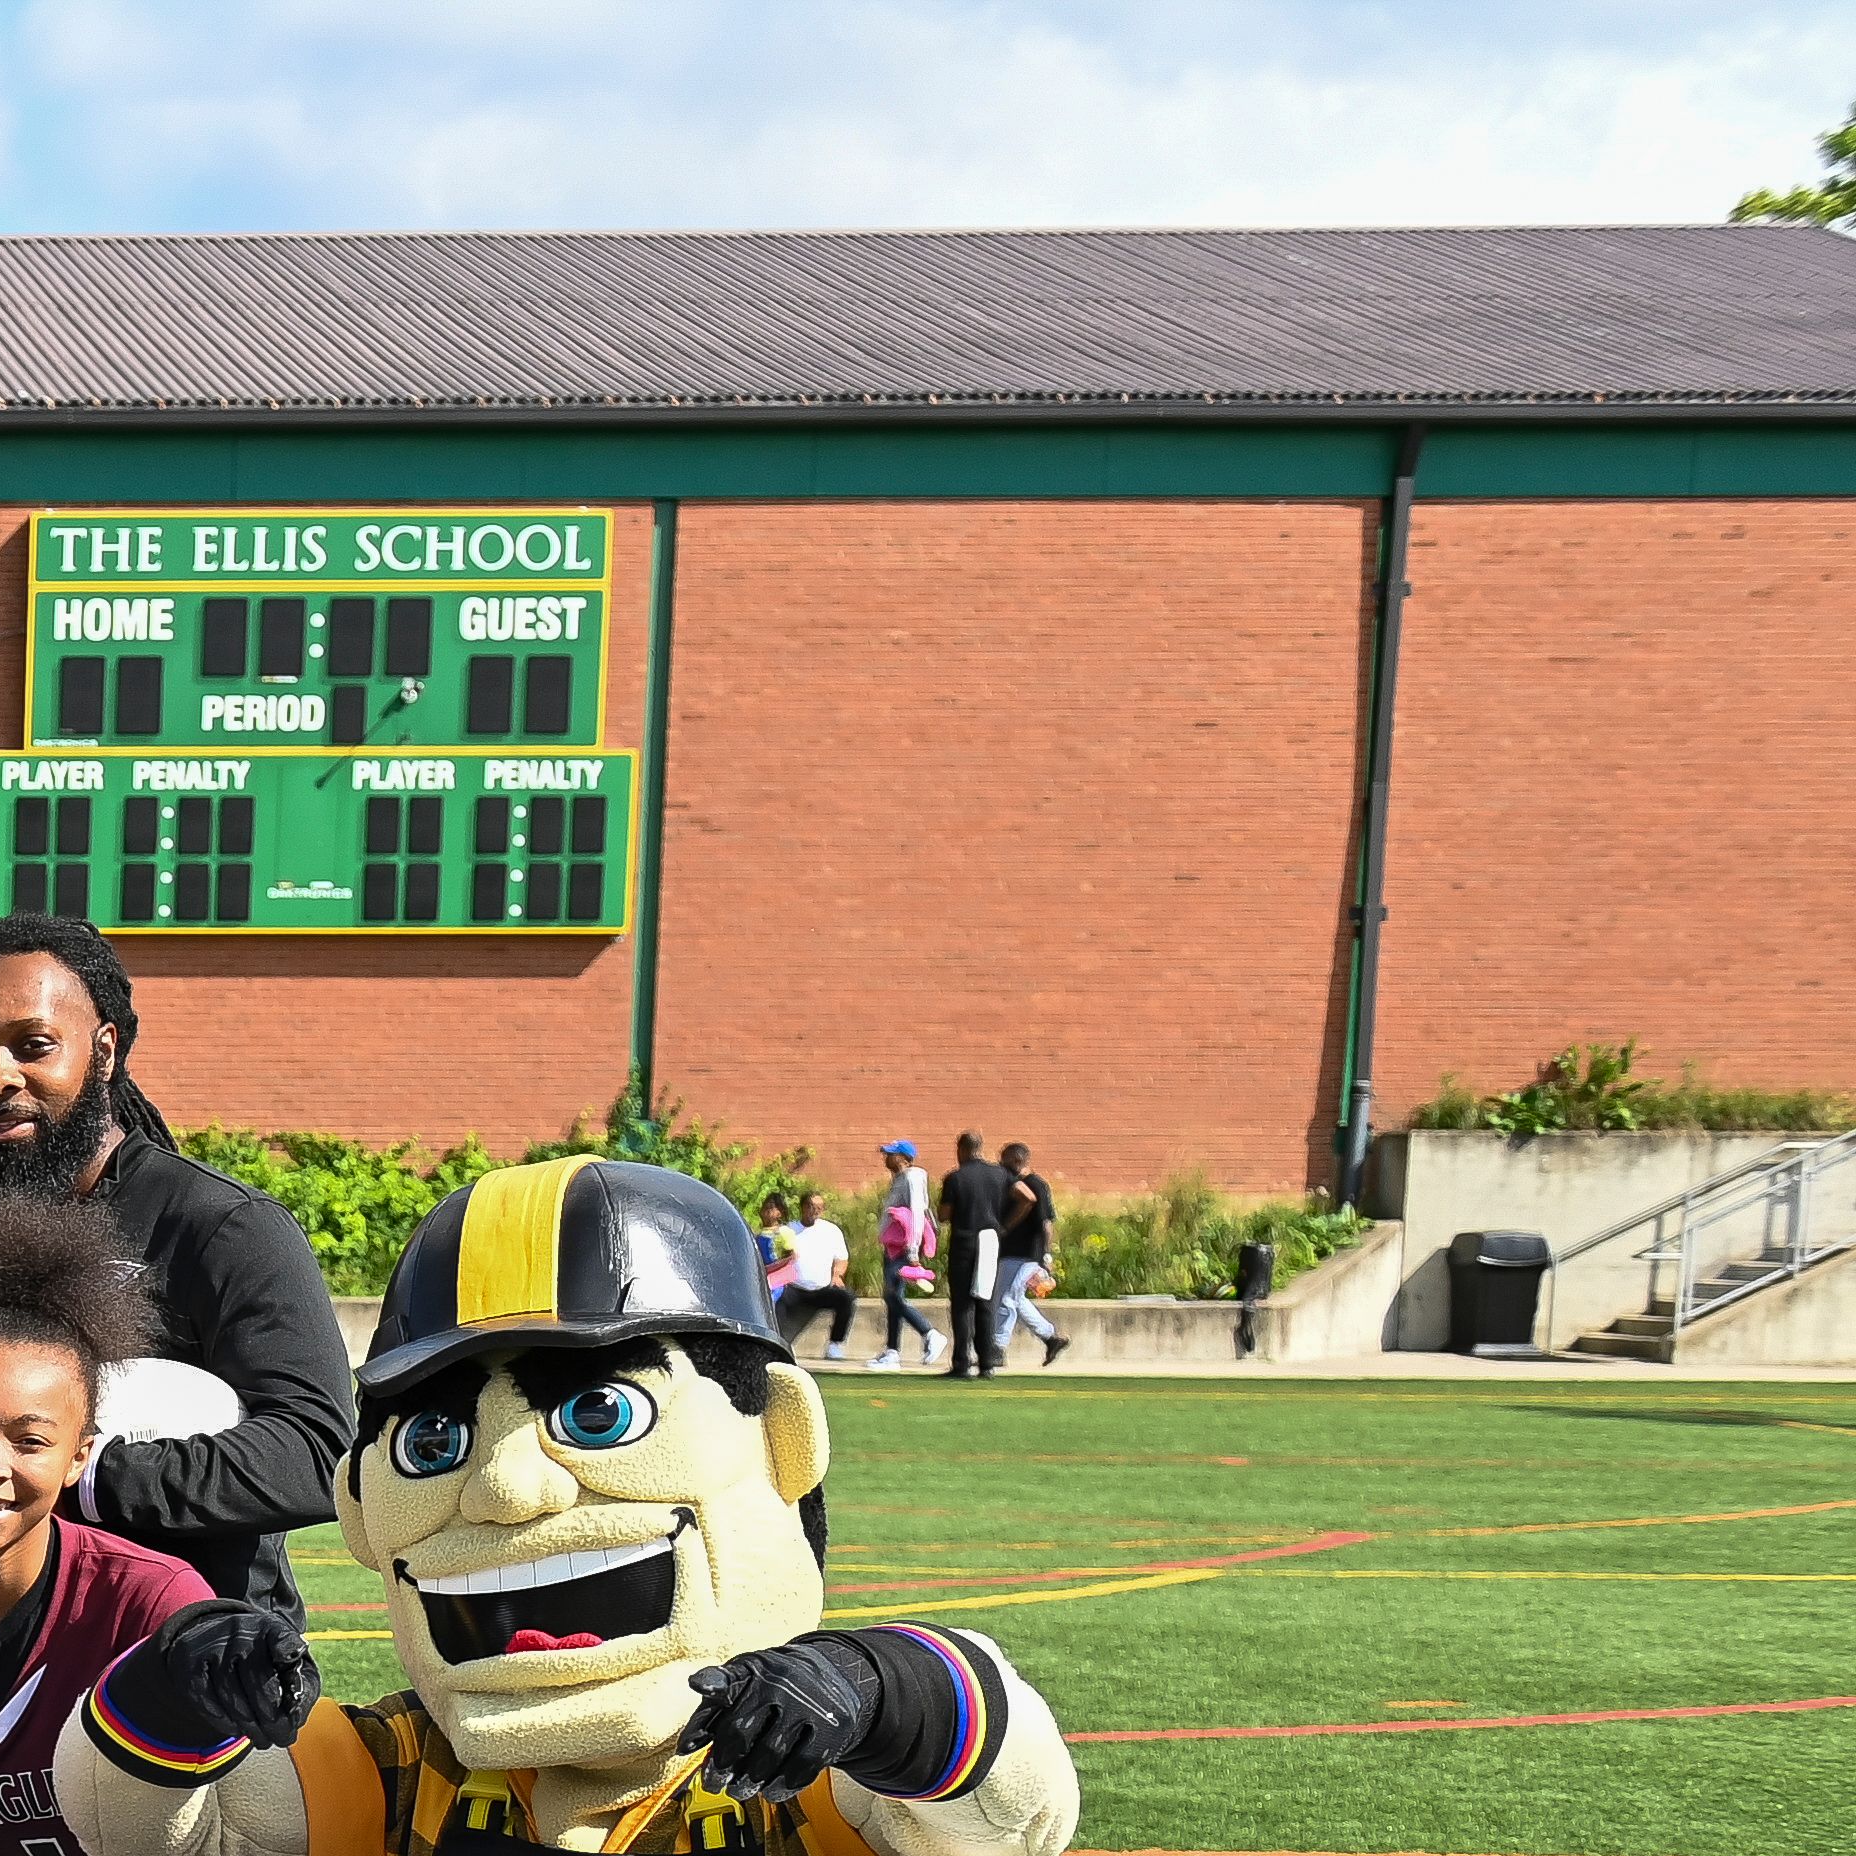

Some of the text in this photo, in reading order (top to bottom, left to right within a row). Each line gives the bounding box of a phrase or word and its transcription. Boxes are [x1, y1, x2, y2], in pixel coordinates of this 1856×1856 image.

[49, 524, 592, 573] THE ELLIS SCHOOL
[53, 597, 175, 642] HOME
[458, 596, 587, 641] GUEST
[201, 694, 326, 732] PERIOD
[1, 760, 104, 791] PLAYER
[132, 759, 251, 791] PENALTY
[352, 759, 456, 791] PLAYER
[484, 759, 604, 790] PENALTY
